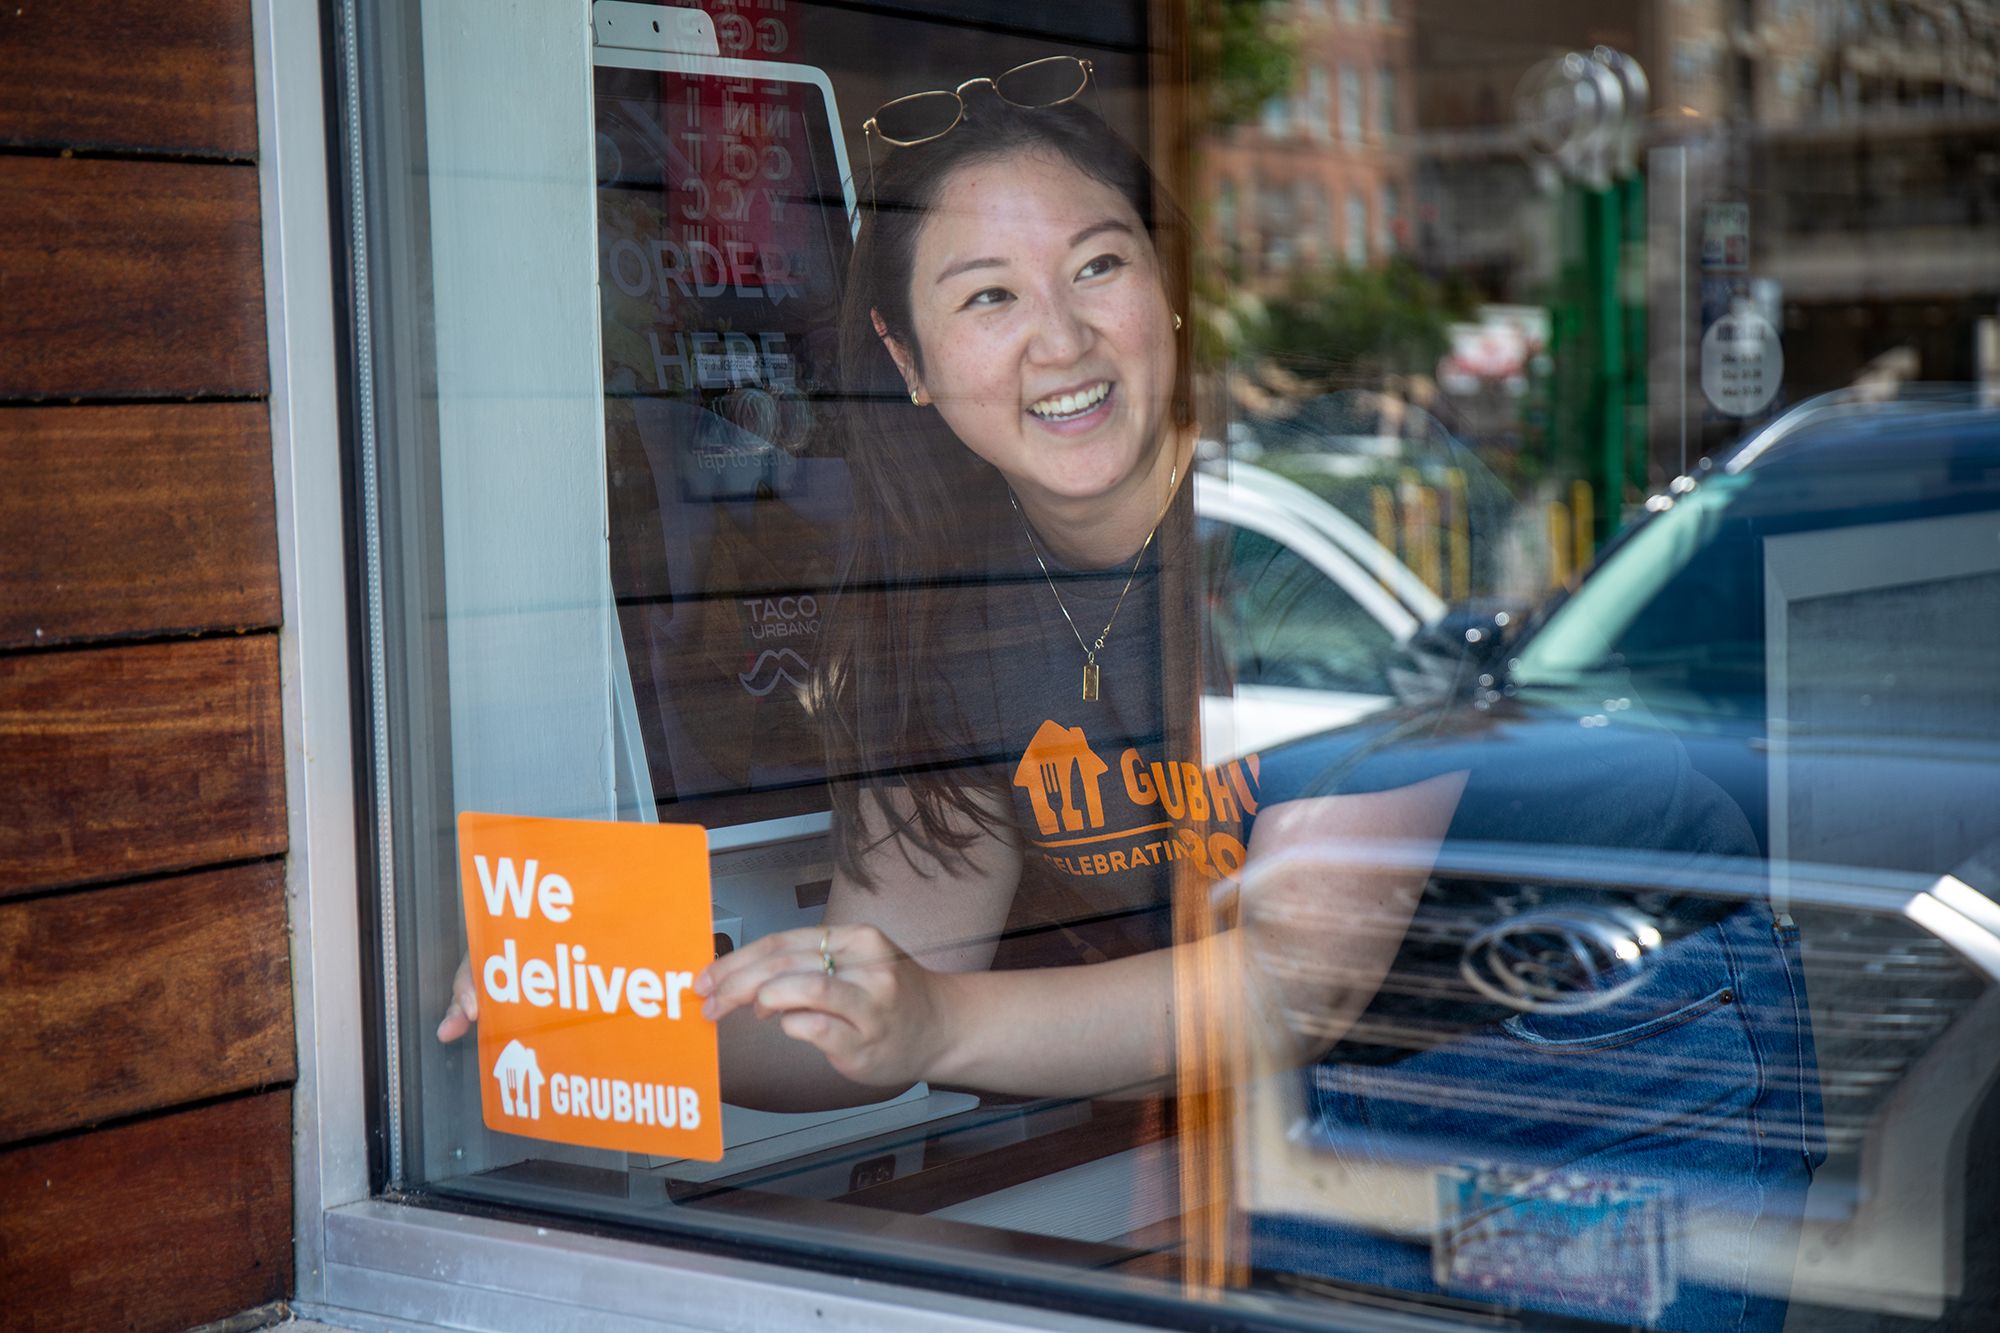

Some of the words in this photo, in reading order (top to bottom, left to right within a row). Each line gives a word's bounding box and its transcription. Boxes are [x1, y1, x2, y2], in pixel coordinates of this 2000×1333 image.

[608, 239, 799, 299] ORDER
[649, 331, 796, 390] HERE
[743, 595, 817, 622] TACO
[750, 620, 821, 640] URBANO
[1043, 838, 1192, 877] ELEBRATIN
[474, 855, 574, 923] We
[483, 938, 694, 1021] deliver
[550, 1072, 701, 1131] GRUBHUB
